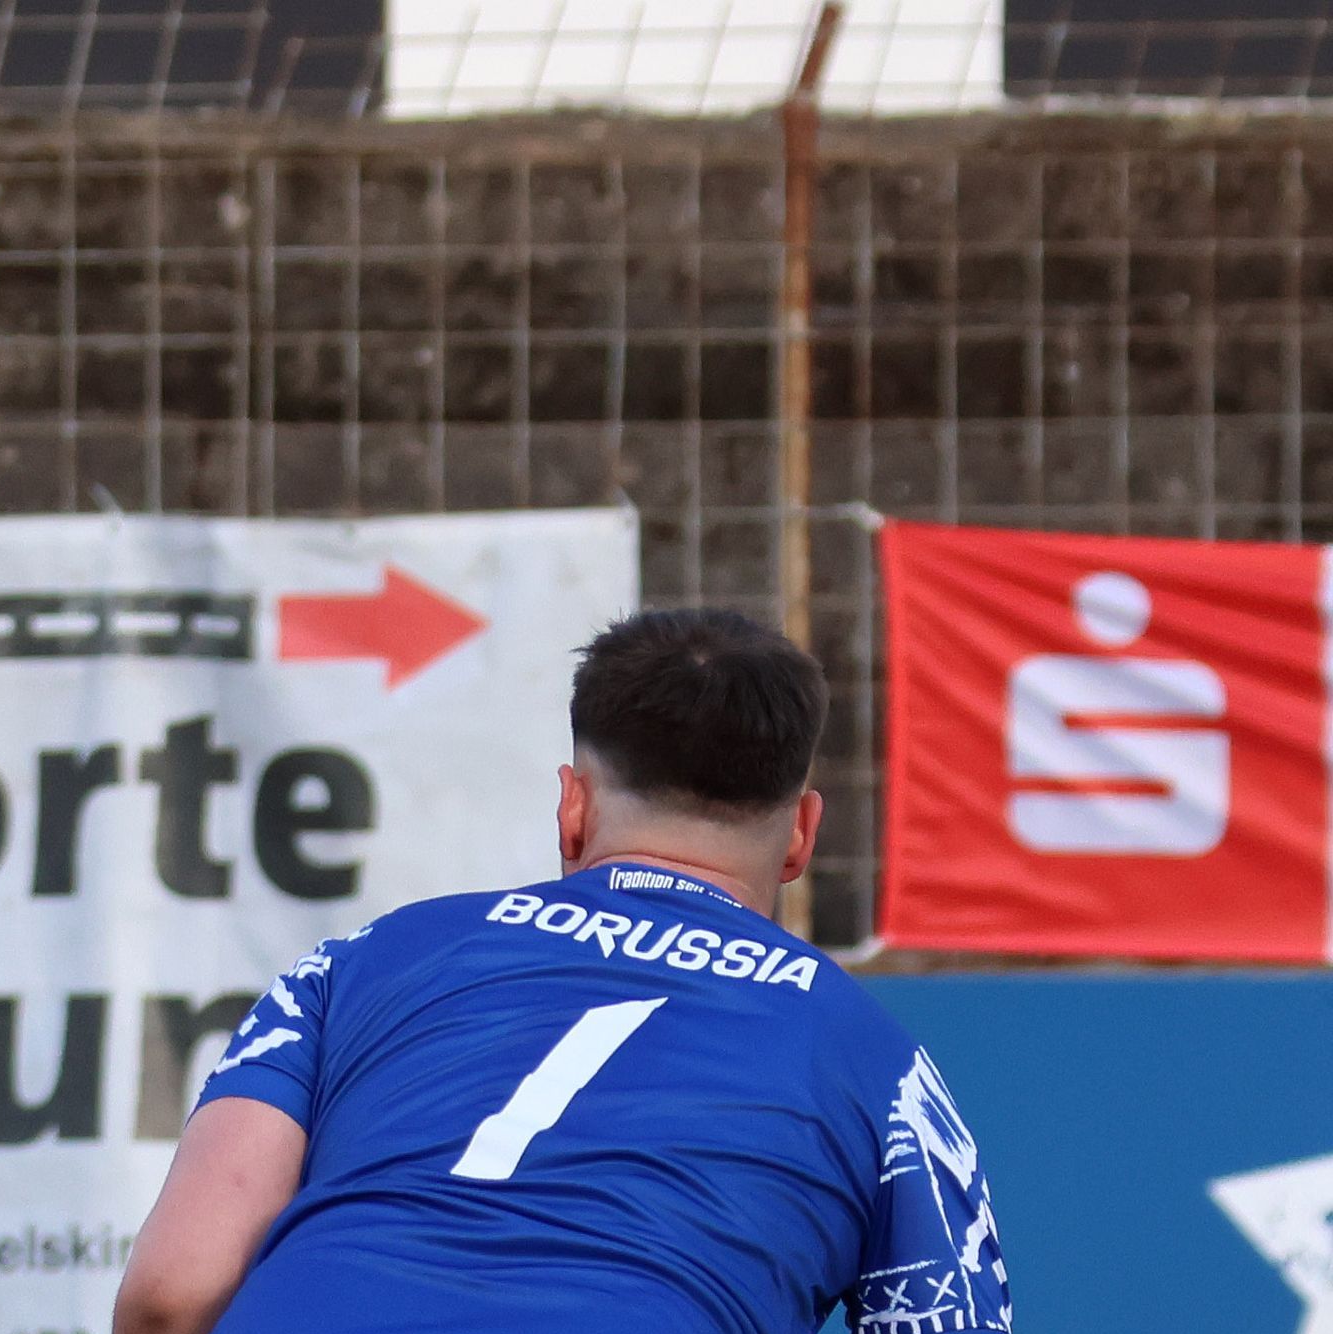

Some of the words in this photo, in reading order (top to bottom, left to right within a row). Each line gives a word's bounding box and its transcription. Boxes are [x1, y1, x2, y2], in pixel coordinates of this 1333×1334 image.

[609, 867, 674, 890] Tradition
[486, 894, 819, 992] BORUSSIA
[450, 997, 669, 1180] 1
